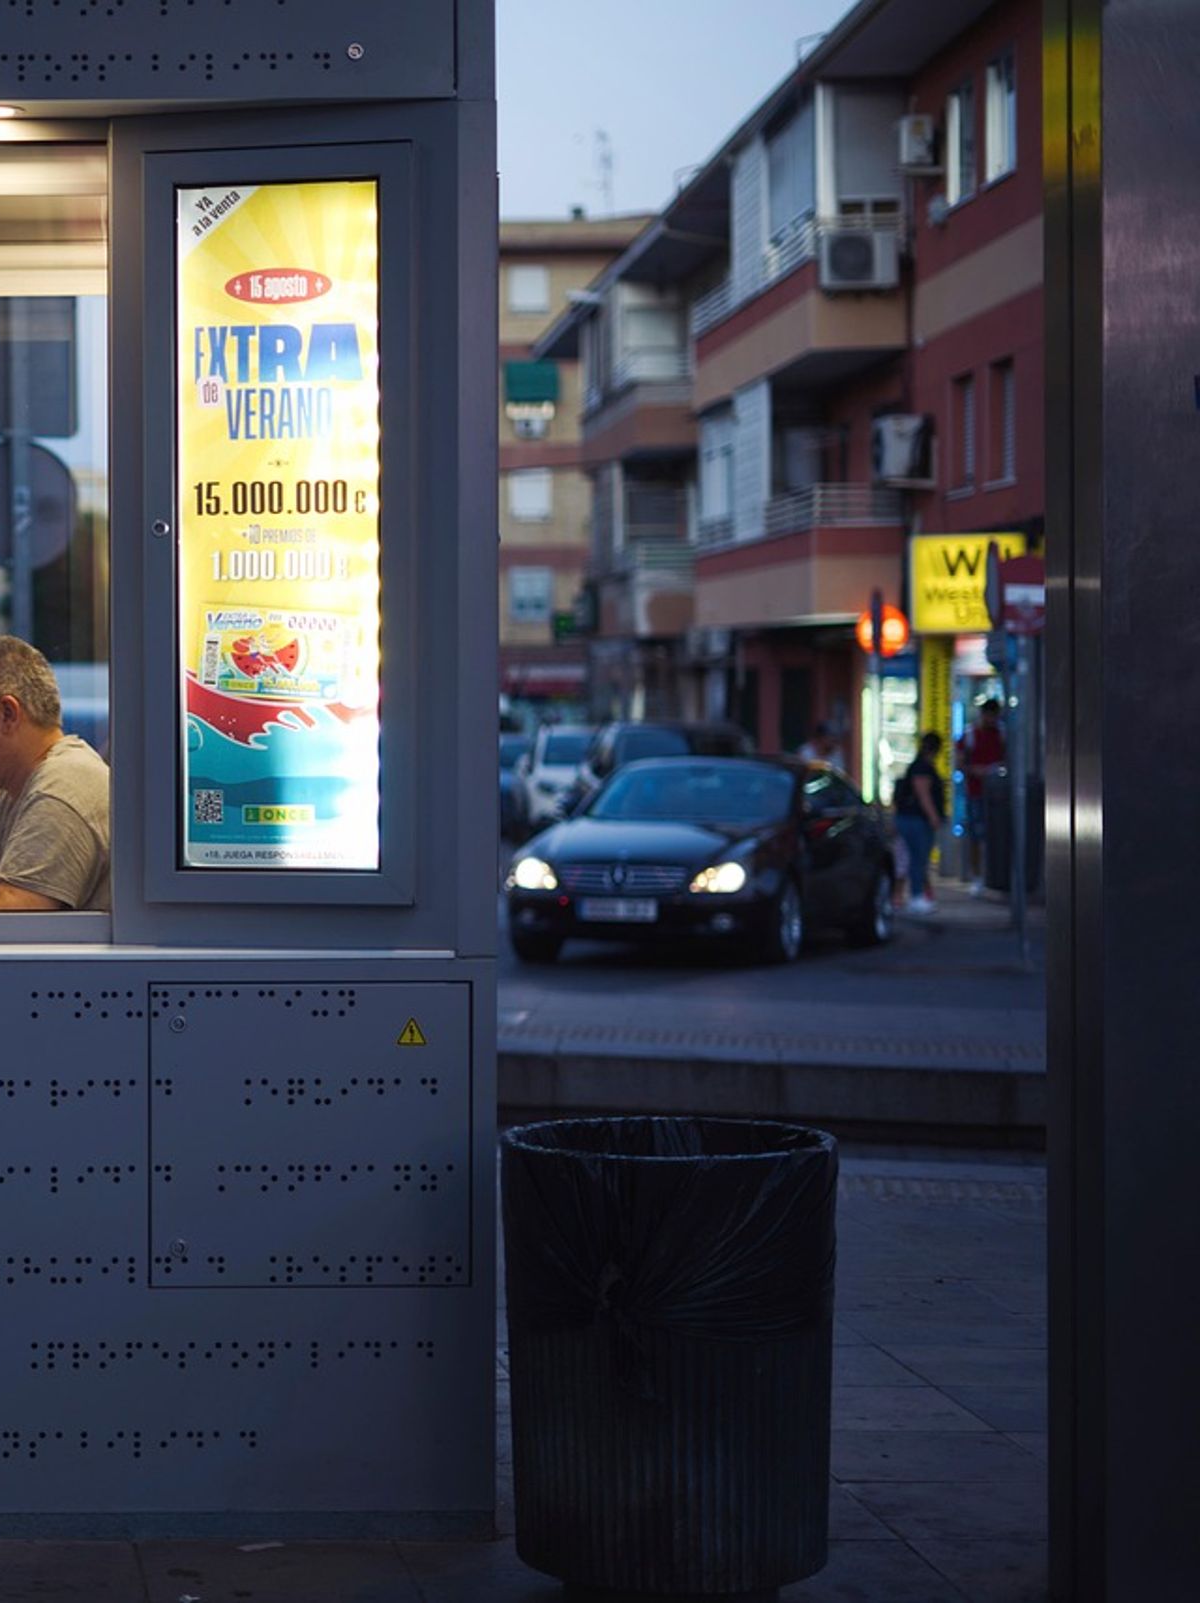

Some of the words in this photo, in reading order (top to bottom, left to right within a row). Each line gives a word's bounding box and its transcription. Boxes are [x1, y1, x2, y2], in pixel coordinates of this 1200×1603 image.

[192, 225, 202, 236] a
[198, 216, 212, 230] la
[209, 190, 241, 219] venta
[195, 196, 213, 212] YA
[264, 273, 308, 300] agosto
[195, 323, 363, 384] EXTRA
[203, 381, 218, 404] de
[225, 388, 331, 440] VERANO
[193, 480, 347, 516] 15.000.000
[212, 550, 331, 581] 1.000.000
[264, 808, 311, 822] ONCE
[223, 850, 253, 860] JUEGA
